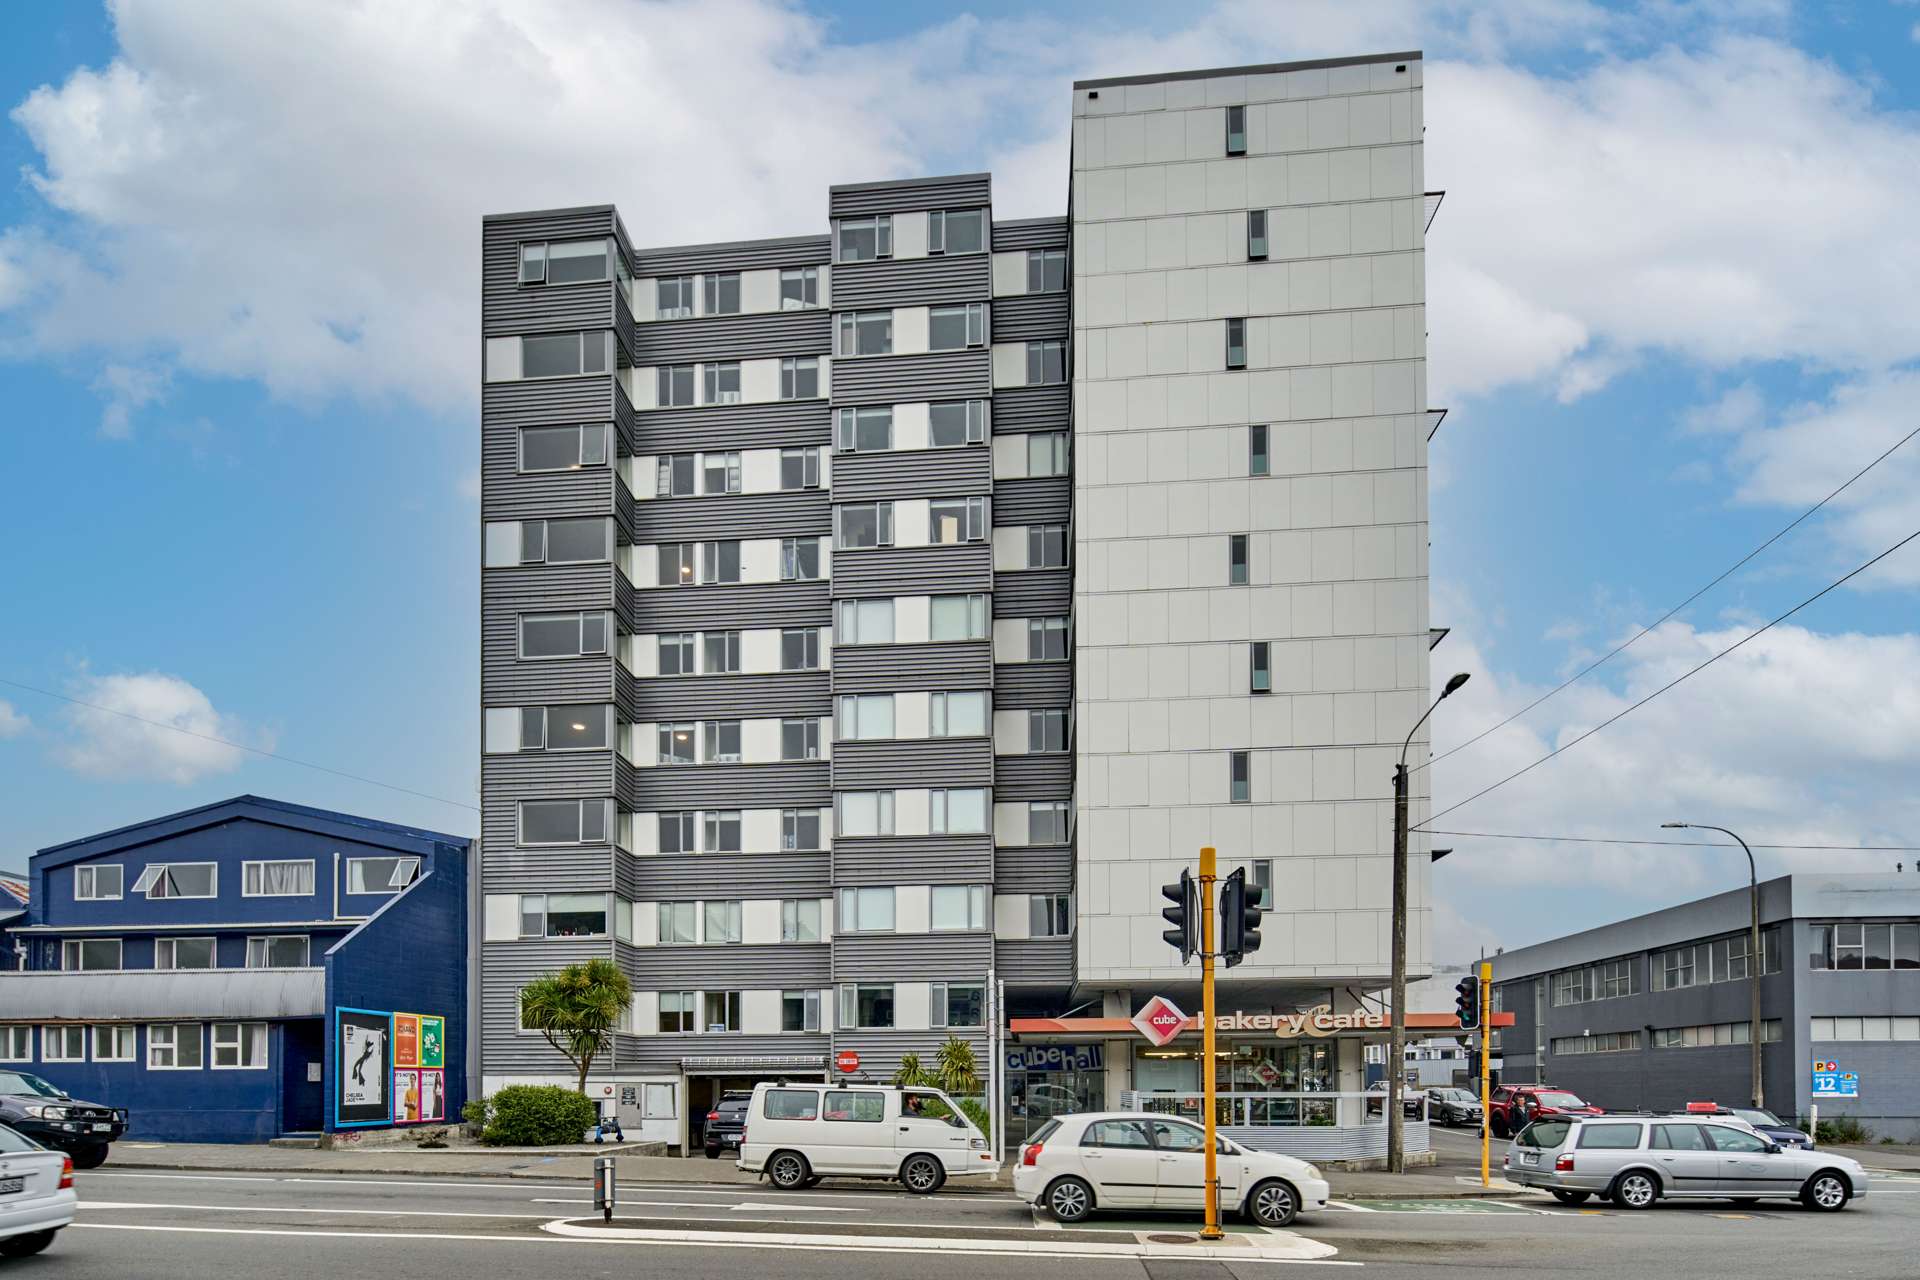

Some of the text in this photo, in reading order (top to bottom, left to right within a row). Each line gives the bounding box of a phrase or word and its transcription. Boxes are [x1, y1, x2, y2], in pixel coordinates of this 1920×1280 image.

[1153, 1014, 1177, 1025] cube
[1314, 1008, 1383, 1029] cafe
[1816, 1062, 1824, 1071] P
